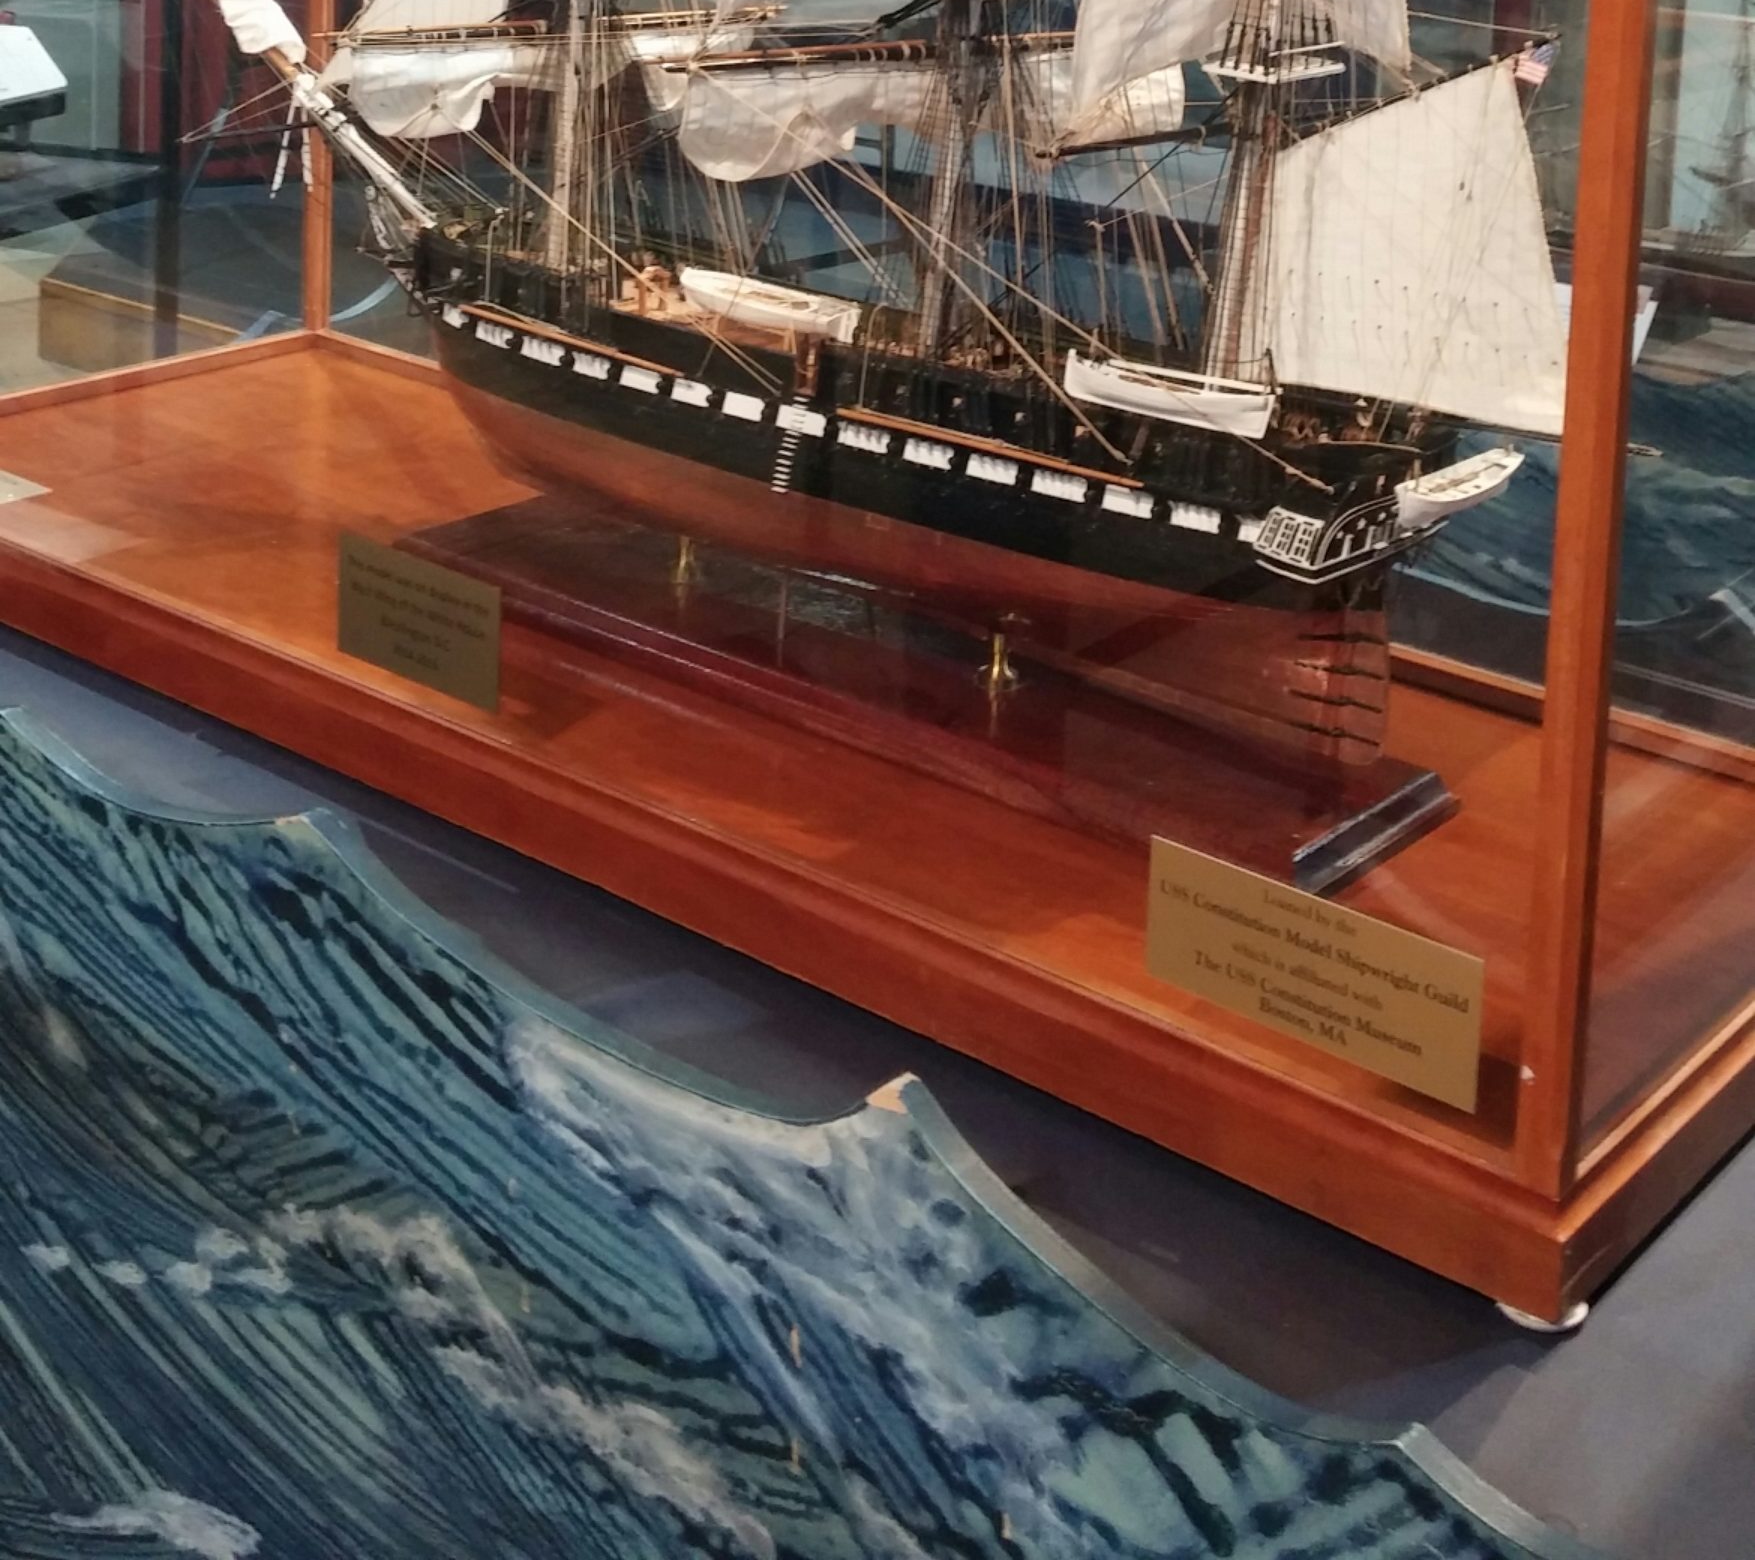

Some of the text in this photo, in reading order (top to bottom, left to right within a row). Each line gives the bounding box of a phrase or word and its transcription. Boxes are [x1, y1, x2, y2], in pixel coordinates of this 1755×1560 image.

[1162, 879, 1468, 1013] USS Constitution Model Shipwright Guild
[1315, 909, 1331, 928] by
[1334, 919, 1357, 936] the
[1195, 950, 1421, 1055] The USS Constitution Museum
[1261, 998, 1346, 1044] Boston, MA
